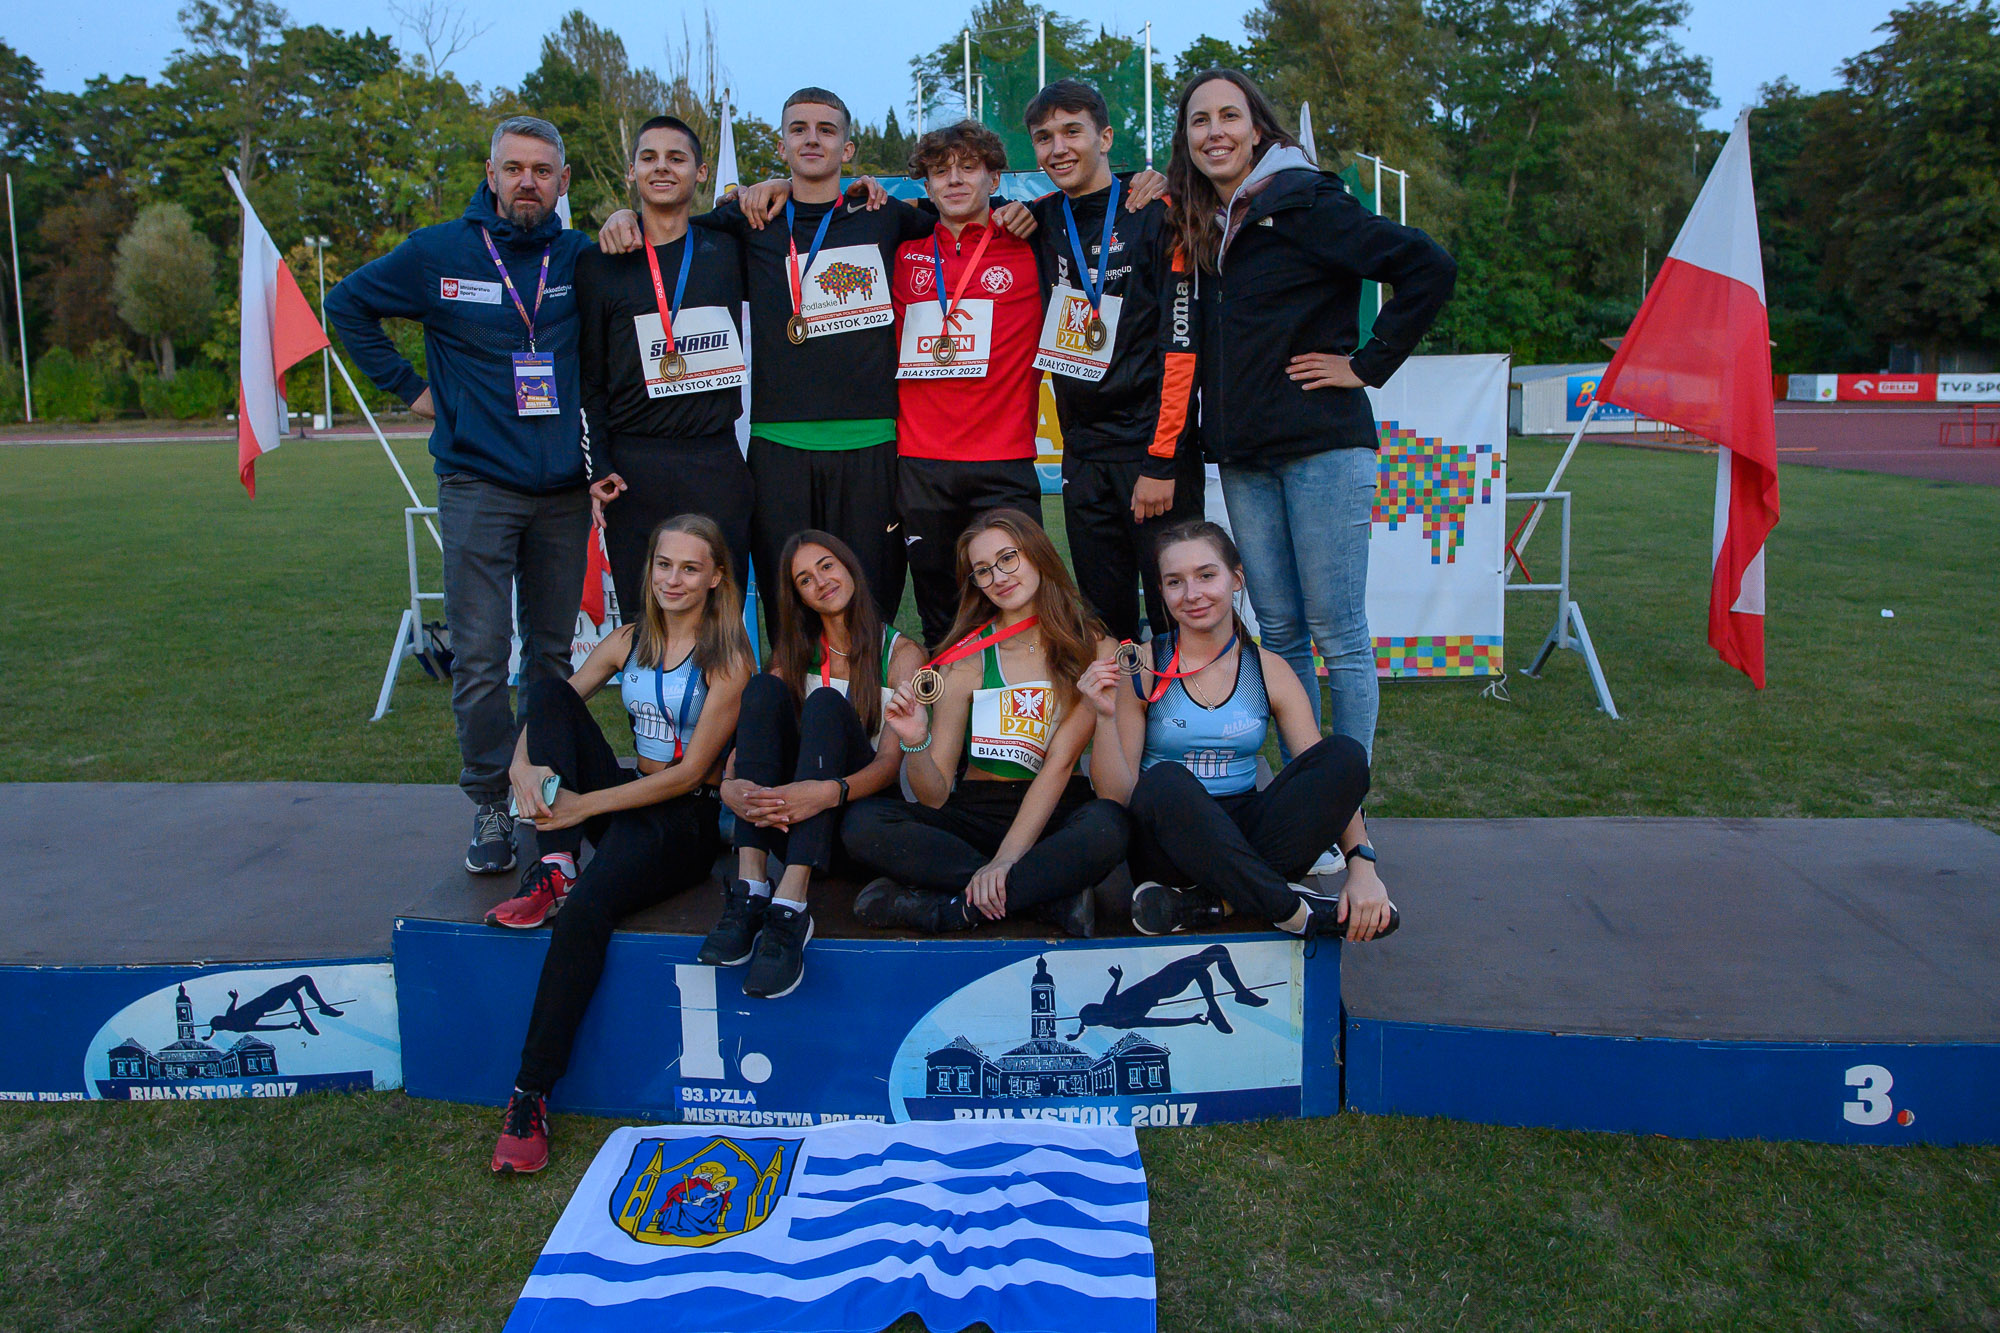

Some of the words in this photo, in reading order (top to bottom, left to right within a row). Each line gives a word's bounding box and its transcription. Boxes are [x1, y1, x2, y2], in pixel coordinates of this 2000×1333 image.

[801, 300, 838, 312] Podlaskie
[806, 319, 861, 335] IAŁYSTOK
[864, 313, 888, 325] 2022
[902, 367, 954, 377] BIAŁYSTOK
[958, 367, 982, 375] 2022
[1038, 358, 1082, 375] BIAŁYSTOK
[1083, 368, 1102, 379] 2022
[654, 379, 712, 395] BIAŁYSTOK
[716, 375, 742, 386] 2022
[1940, 381, 1972, 392] TVP
[1003, 717, 1045, 741] PZLA
[978, 747, 1033, 765] BIAŁYSTOK
[1183, 749, 1237, 779] 107
[39, 1092, 83, 1101] POLSKI
[129, 1084, 243, 1100] BIAŁYSTOK
[252, 1082, 298, 1098] 2017
[683, 1107, 813, 1127] MISTRZOSTWA
[1131, 1102, 1198, 1127] 2017
